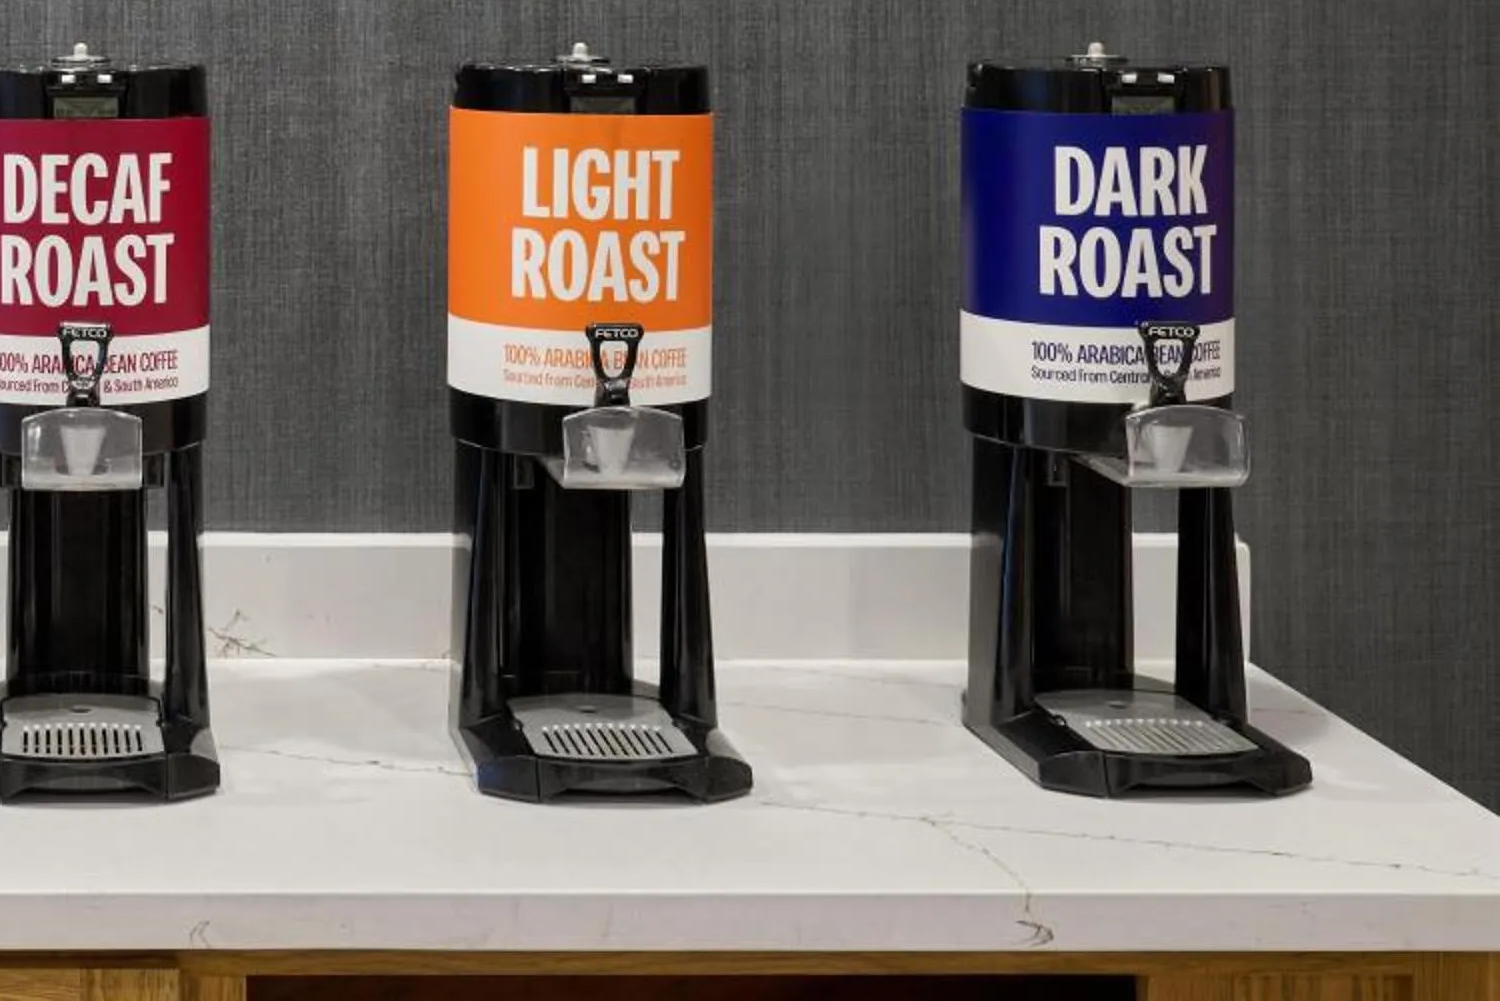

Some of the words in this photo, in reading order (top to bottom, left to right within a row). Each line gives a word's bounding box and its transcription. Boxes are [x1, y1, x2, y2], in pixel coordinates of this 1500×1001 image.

[3, 153, 172, 225] DECAF
[522, 147, 680, 220] LIGHT
[1054, 145, 1208, 217] DARK
[1, 234, 175, 307] ROAST
[511, 227, 686, 302] ROAST
[1039, 225, 1217, 298] ROAST
[62, 327, 107, 338] FETCO
[595, 328, 639, 338] FETCO
[1148, 327, 1195, 338] FETCO
[31, 354, 95, 376] ARAICA
[140, 349, 178, 371] COFFEE
[504, 344, 540, 366] 100%
[543, 348, 609, 369] ARABIA
[613, 349, 648, 369] BN
[651, 347, 687, 369] COFFEE
[1031, 340, 1073, 364] 100%
[1077, 344, 1145, 366] ARABICA
[33, 379, 59, 394] From
[1031, 365, 1077, 383] Sourced
[1078, 368, 1108, 383] From
